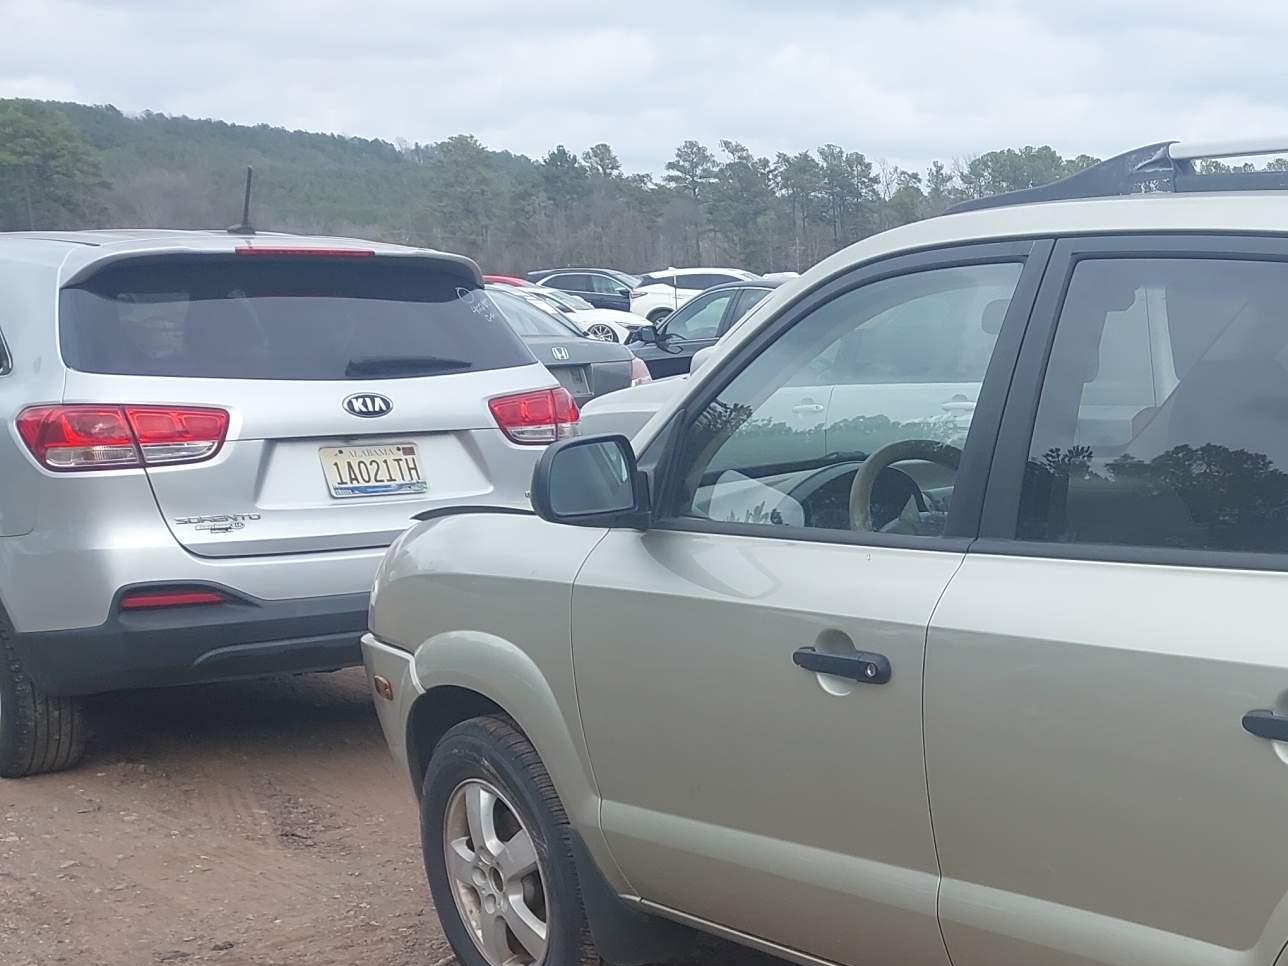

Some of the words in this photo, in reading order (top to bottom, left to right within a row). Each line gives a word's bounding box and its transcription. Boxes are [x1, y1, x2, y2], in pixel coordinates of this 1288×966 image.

[349, 397, 388, 412] KIA
[347, 447, 395, 458] ALABAMA
[332, 457, 421, 485] 1A021TH
[174, 513, 262, 525] SORENTO
